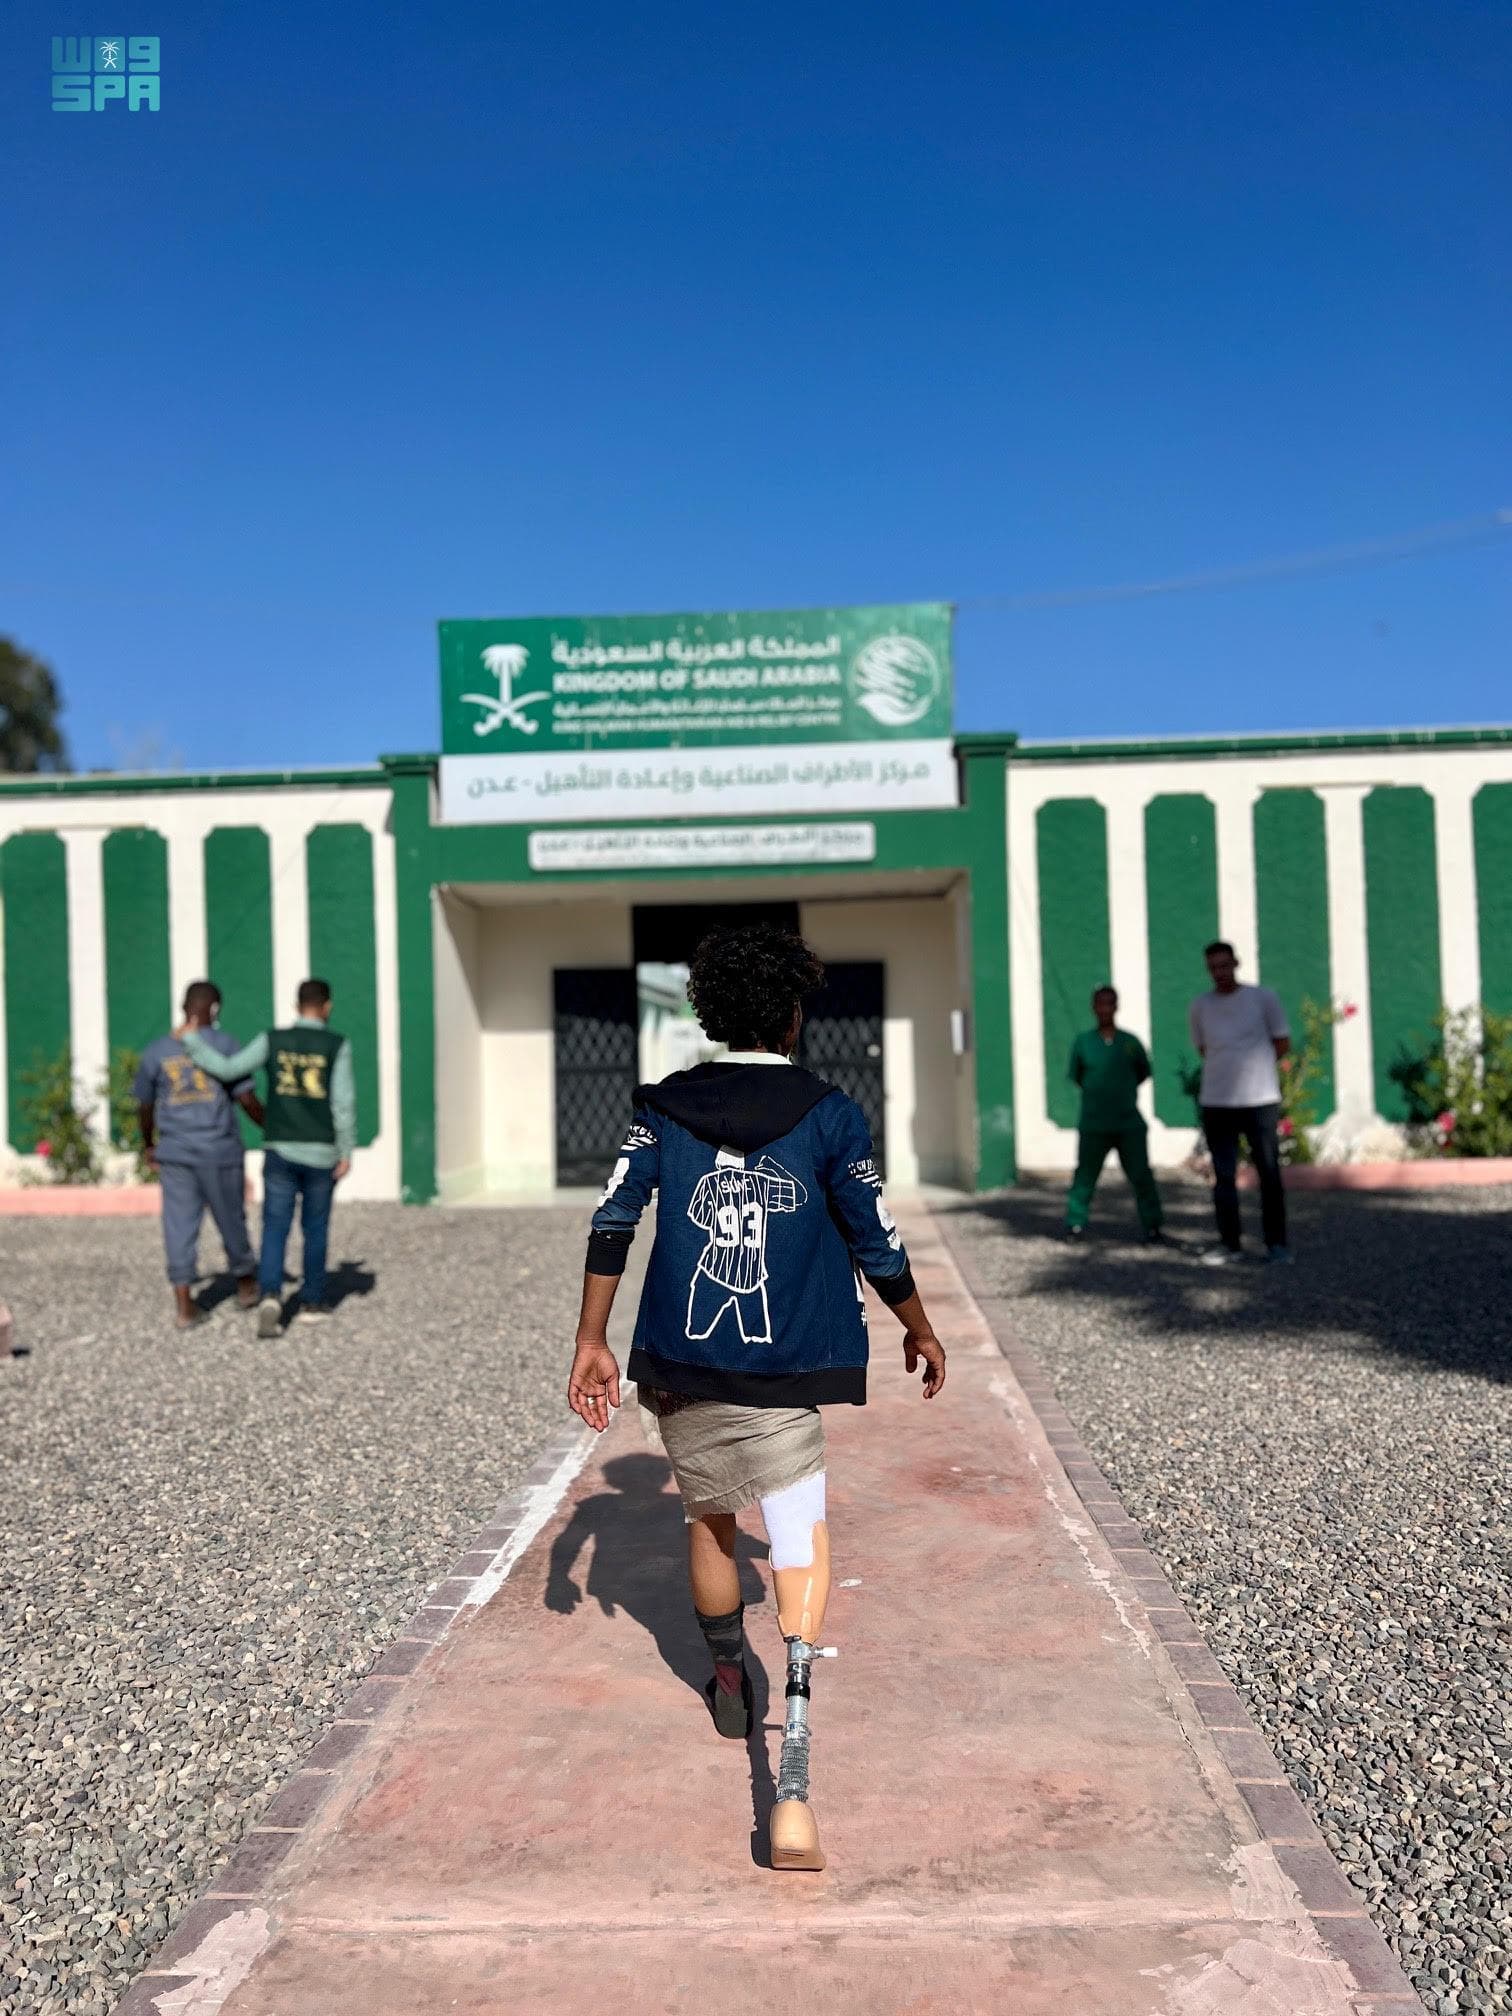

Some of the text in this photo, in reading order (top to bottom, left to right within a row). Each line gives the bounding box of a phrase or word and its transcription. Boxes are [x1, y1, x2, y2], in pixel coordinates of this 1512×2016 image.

[551, 634, 841, 668] المملكة العربية السعودية
[552, 664, 841, 694] KINGDOM OF SAUDI ARABIA
[699, 763, 789, 790] الصناعية
[879, 759, 930, 786] مركز
[467, 775, 519, 800] عدن
[715, 1201, 763, 1249] 93
